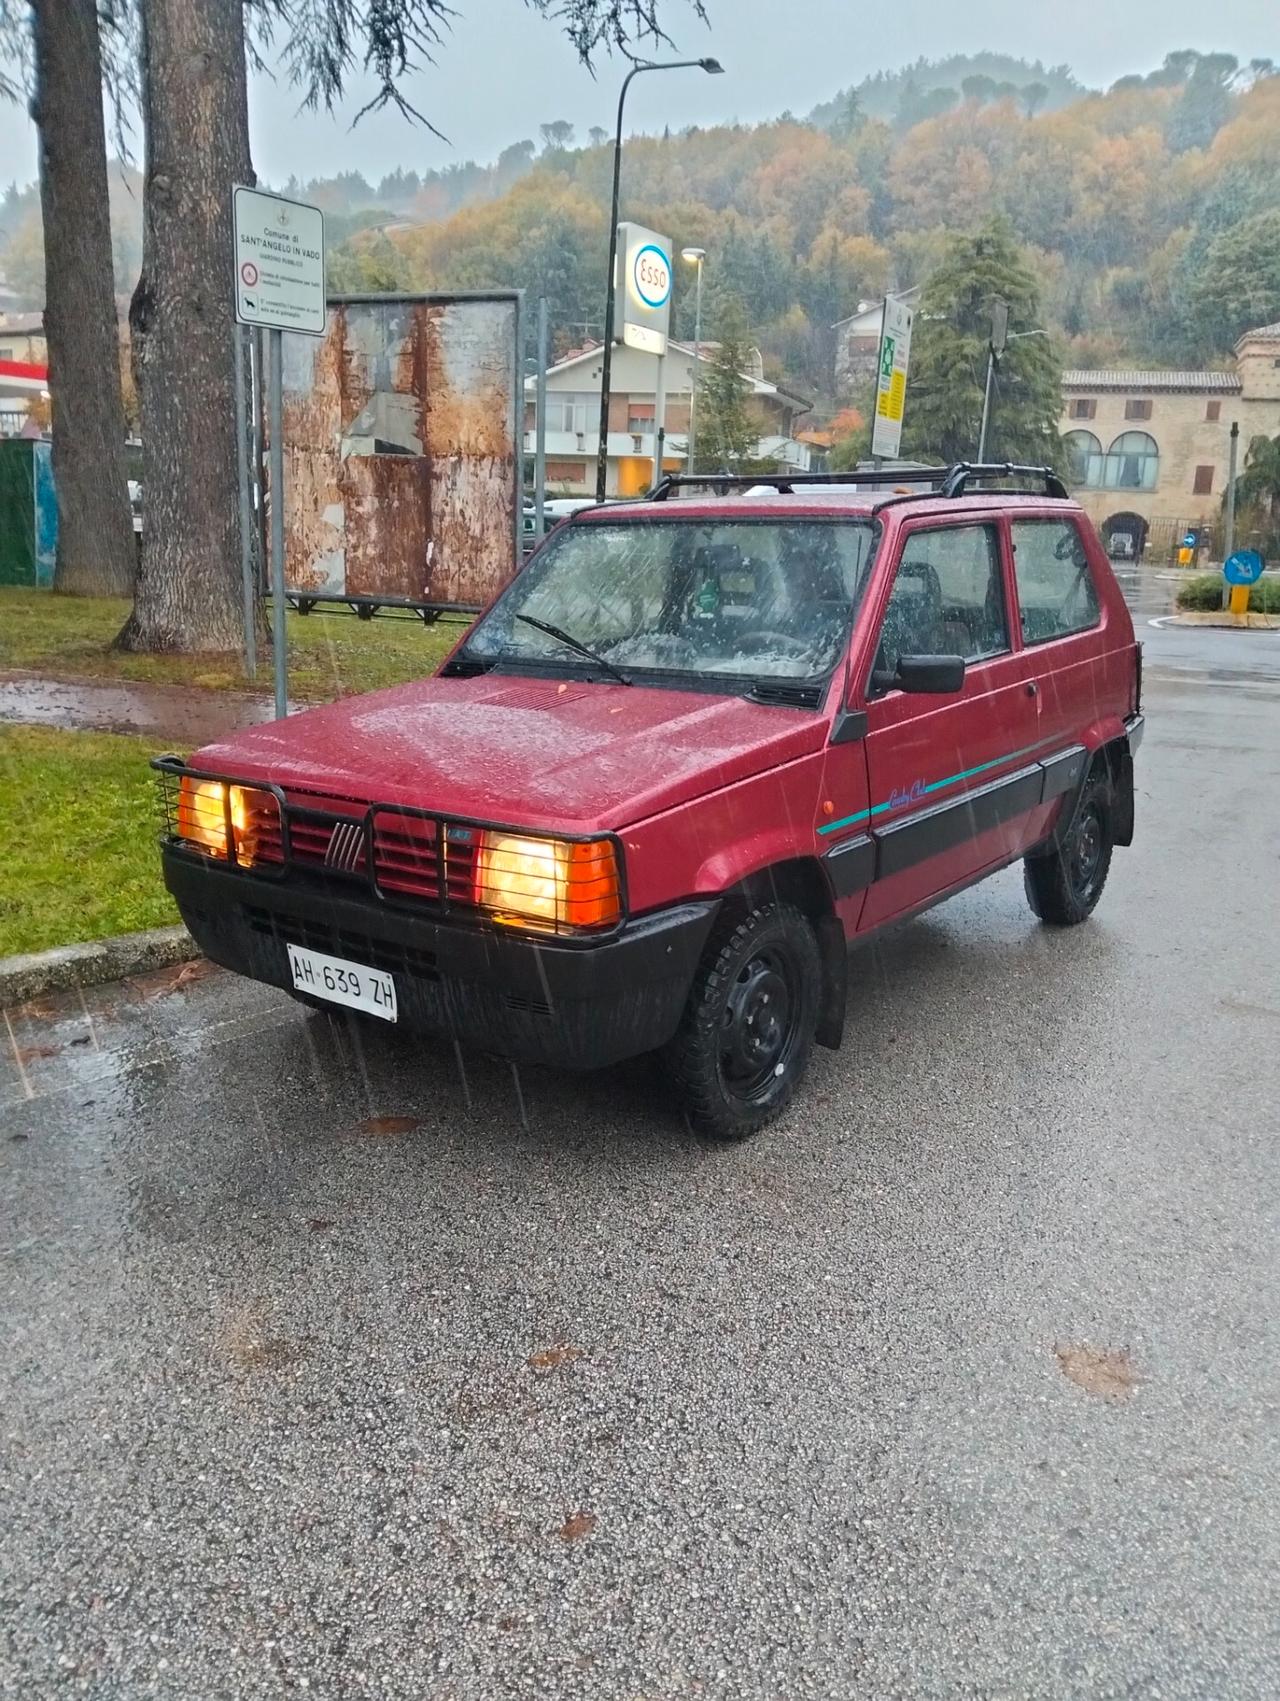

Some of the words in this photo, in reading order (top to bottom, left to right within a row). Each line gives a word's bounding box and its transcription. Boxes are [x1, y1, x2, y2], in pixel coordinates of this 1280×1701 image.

[240, 234, 291, 254] SANT'ANGELO
[292, 246, 301, 256] IN
[301, 249, 320, 260] VADO
[263, 227, 289, 241] Comune
[292, 235, 299, 243] di
[293, 956, 315, 985] AH
[323, 966, 361, 997] 639
[369, 978, 394, 1010] ZH
